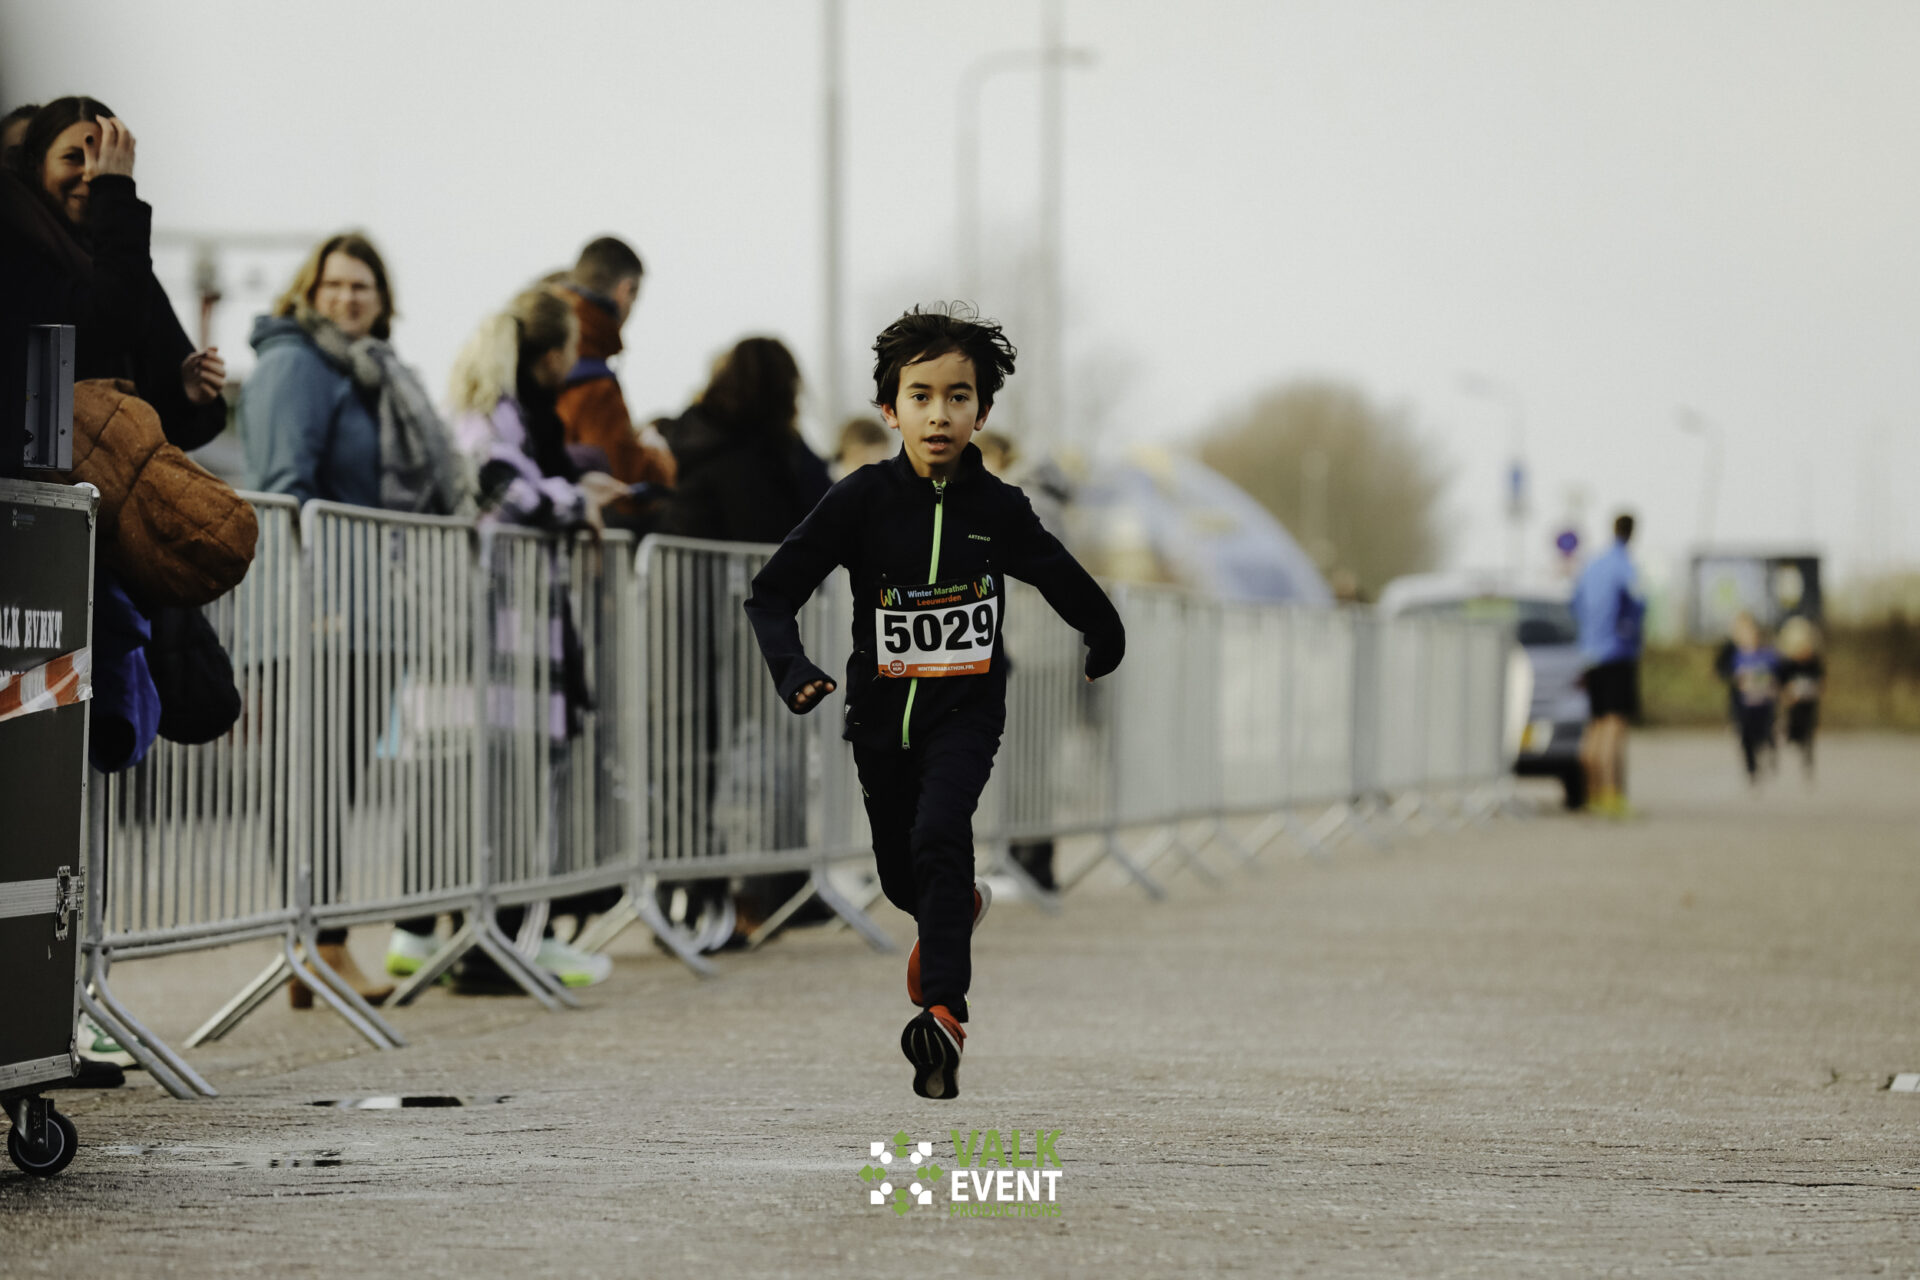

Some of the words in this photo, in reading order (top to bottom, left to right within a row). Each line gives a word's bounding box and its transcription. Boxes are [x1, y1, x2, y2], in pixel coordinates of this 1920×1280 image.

[907, 589, 932, 599] Winter
[933, 583, 968, 596] Marathon
[917, 594, 962, 607] Leeuwarden
[0, 607, 20, 648] LK
[24, 610, 62, 648] EVENT
[883, 603, 995, 654] 5029
